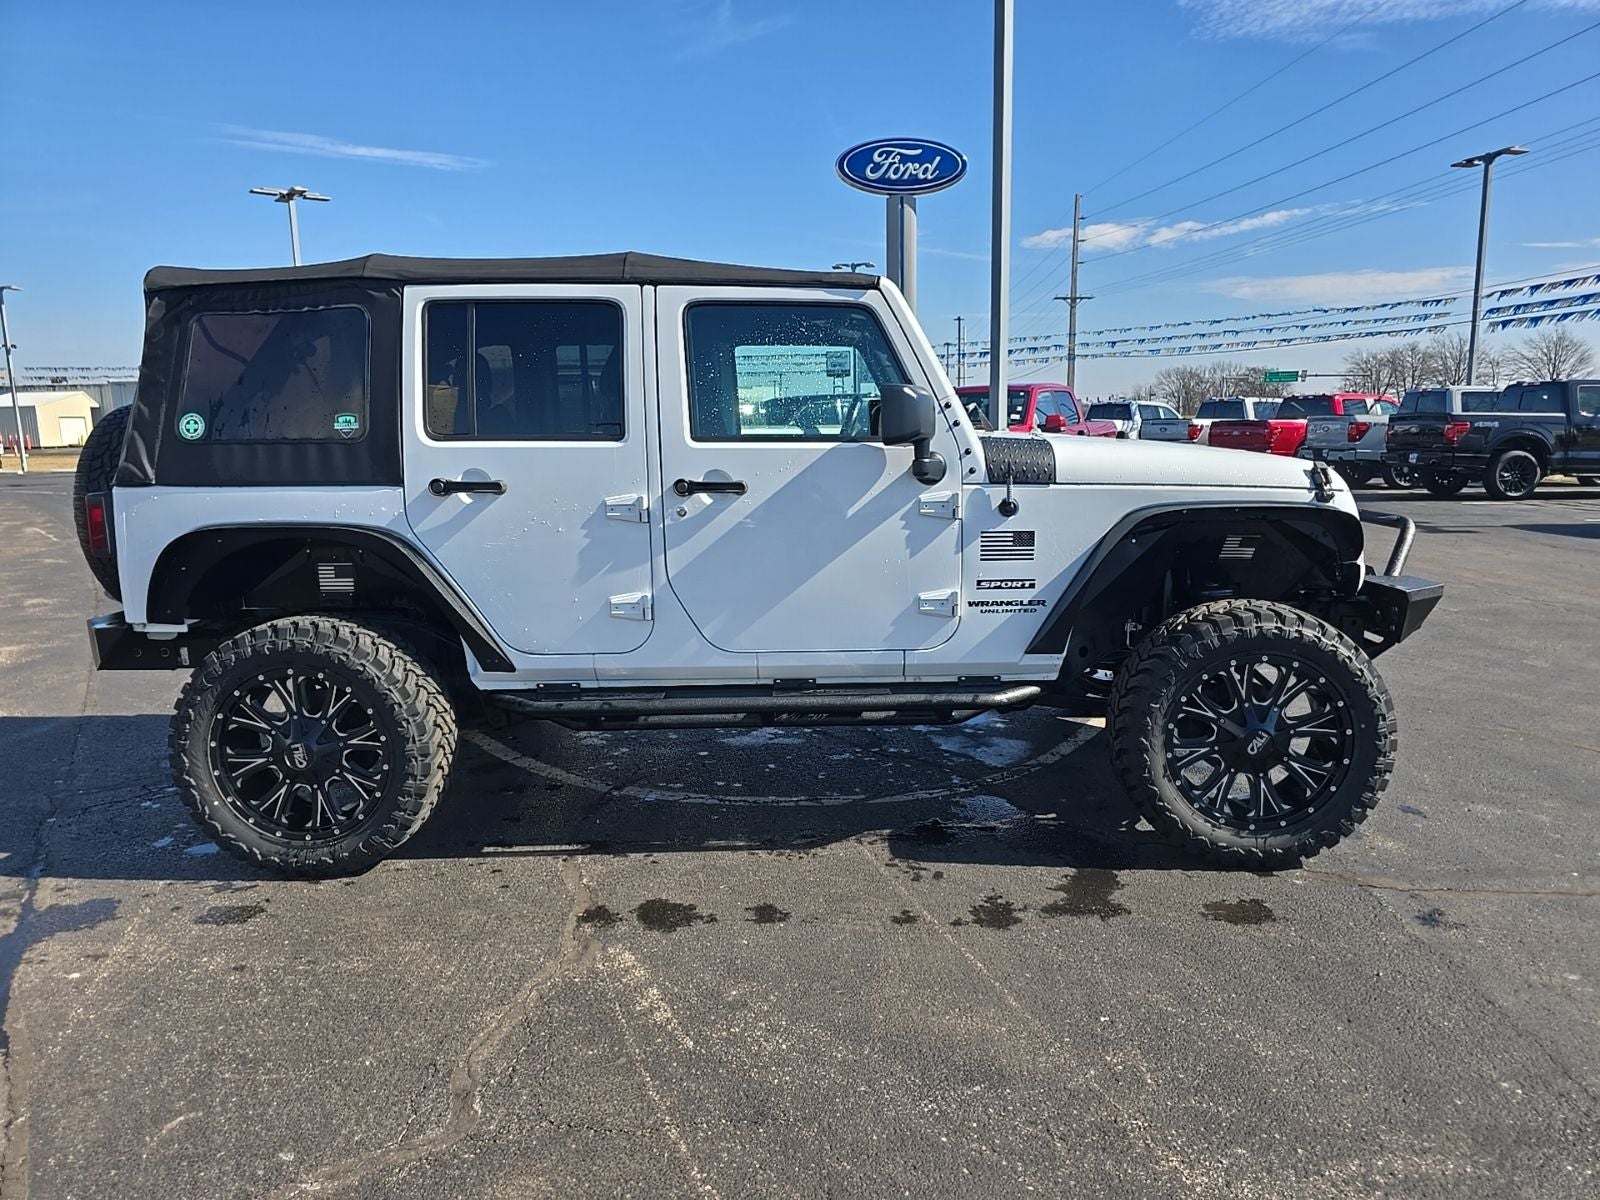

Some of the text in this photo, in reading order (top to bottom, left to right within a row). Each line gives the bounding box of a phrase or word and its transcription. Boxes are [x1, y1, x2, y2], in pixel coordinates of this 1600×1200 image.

[865, 147, 941, 180] Ford
[980, 581, 1032, 589] SPORT
[967, 599, 1047, 608] WRANGLER
